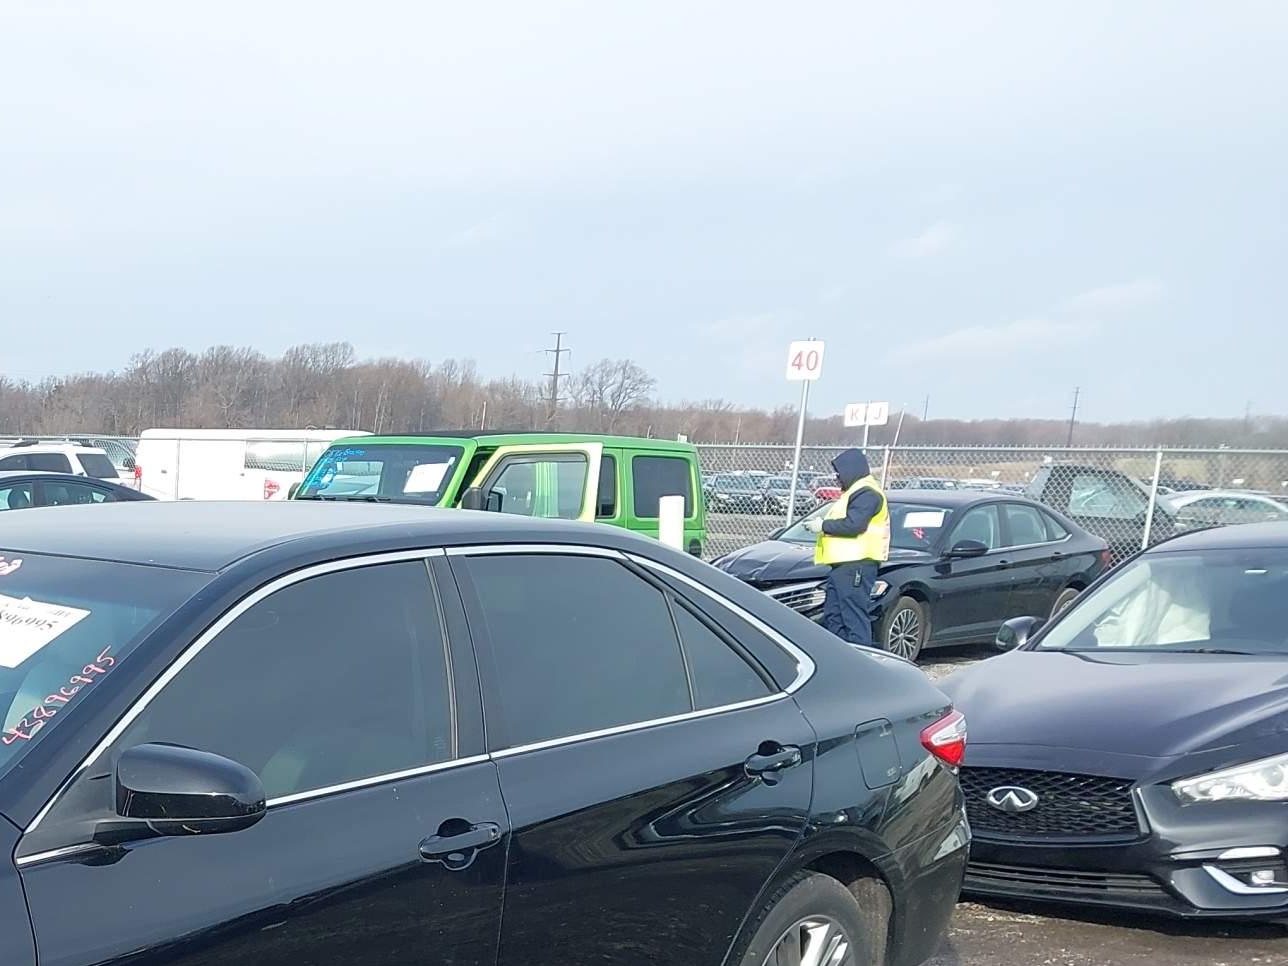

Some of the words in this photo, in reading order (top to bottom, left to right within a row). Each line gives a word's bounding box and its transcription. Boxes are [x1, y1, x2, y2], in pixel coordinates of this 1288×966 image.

[791, 350, 819, 371] 40
[851, 408, 860, 421] K
[874, 408, 882, 421] J
[1, 644, 115, 745] 43896995
